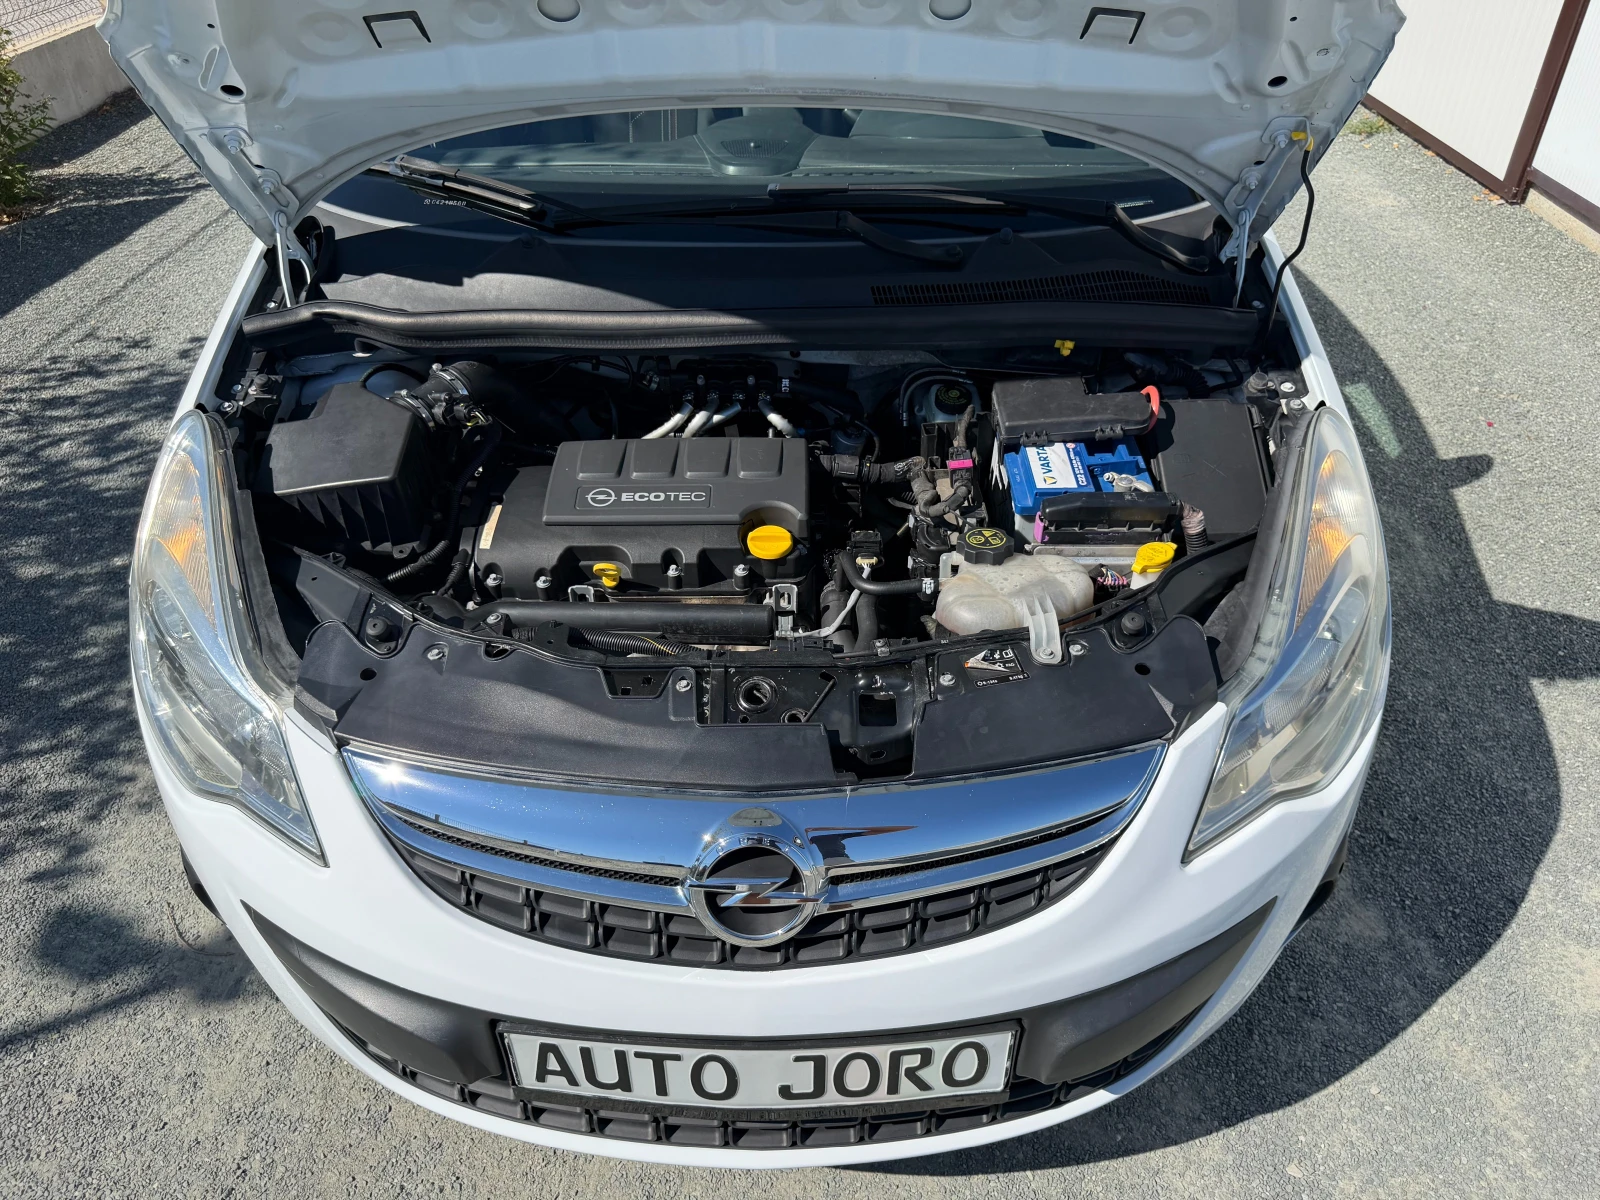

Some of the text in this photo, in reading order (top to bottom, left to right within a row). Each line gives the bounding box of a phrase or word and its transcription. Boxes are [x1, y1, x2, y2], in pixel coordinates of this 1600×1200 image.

[1036, 445, 1053, 474] VARTA
[621, 492, 706, 501] ECOTEC
[535, 1040, 990, 1101] AUTO JORO
